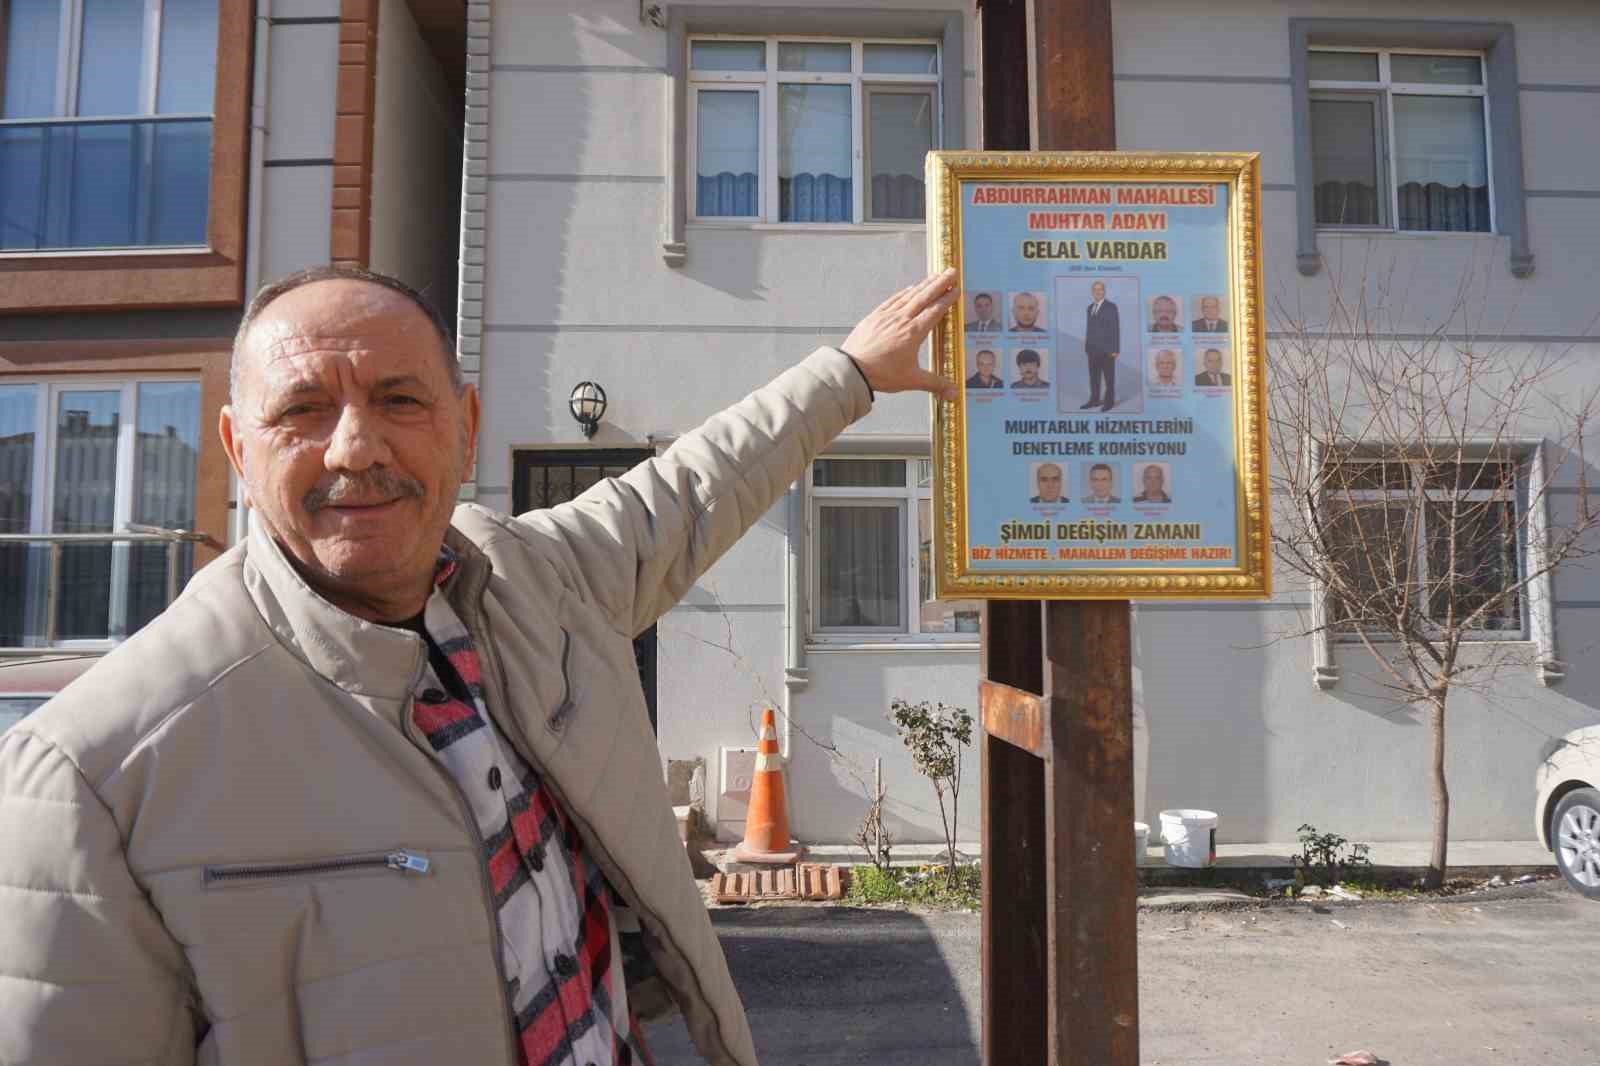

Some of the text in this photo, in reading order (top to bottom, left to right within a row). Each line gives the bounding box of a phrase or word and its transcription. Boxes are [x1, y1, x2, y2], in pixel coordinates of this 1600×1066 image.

[974, 184, 1214, 204] ABDURRAHMAN MAHALLESİ
[1029, 213, 1166, 230] MUHTAR ADAYI
[1023, 241, 1167, 260] CELAL VARDAR
[1005, 417, 1193, 435] MUHTARLIK HİZMETLERİNİ
[1012, 438, 1186, 456] DENETLEME KOMİSYONU
[1000, 520, 1200, 543] ŞİMDİ DEĞİŞİM ZAMANI
[995, 546, 1047, 560] HİZMETE
[1059, 548, 1125, 560] MAHALLEM
[1130, 545, 1187, 562] DEĞİŞİME
